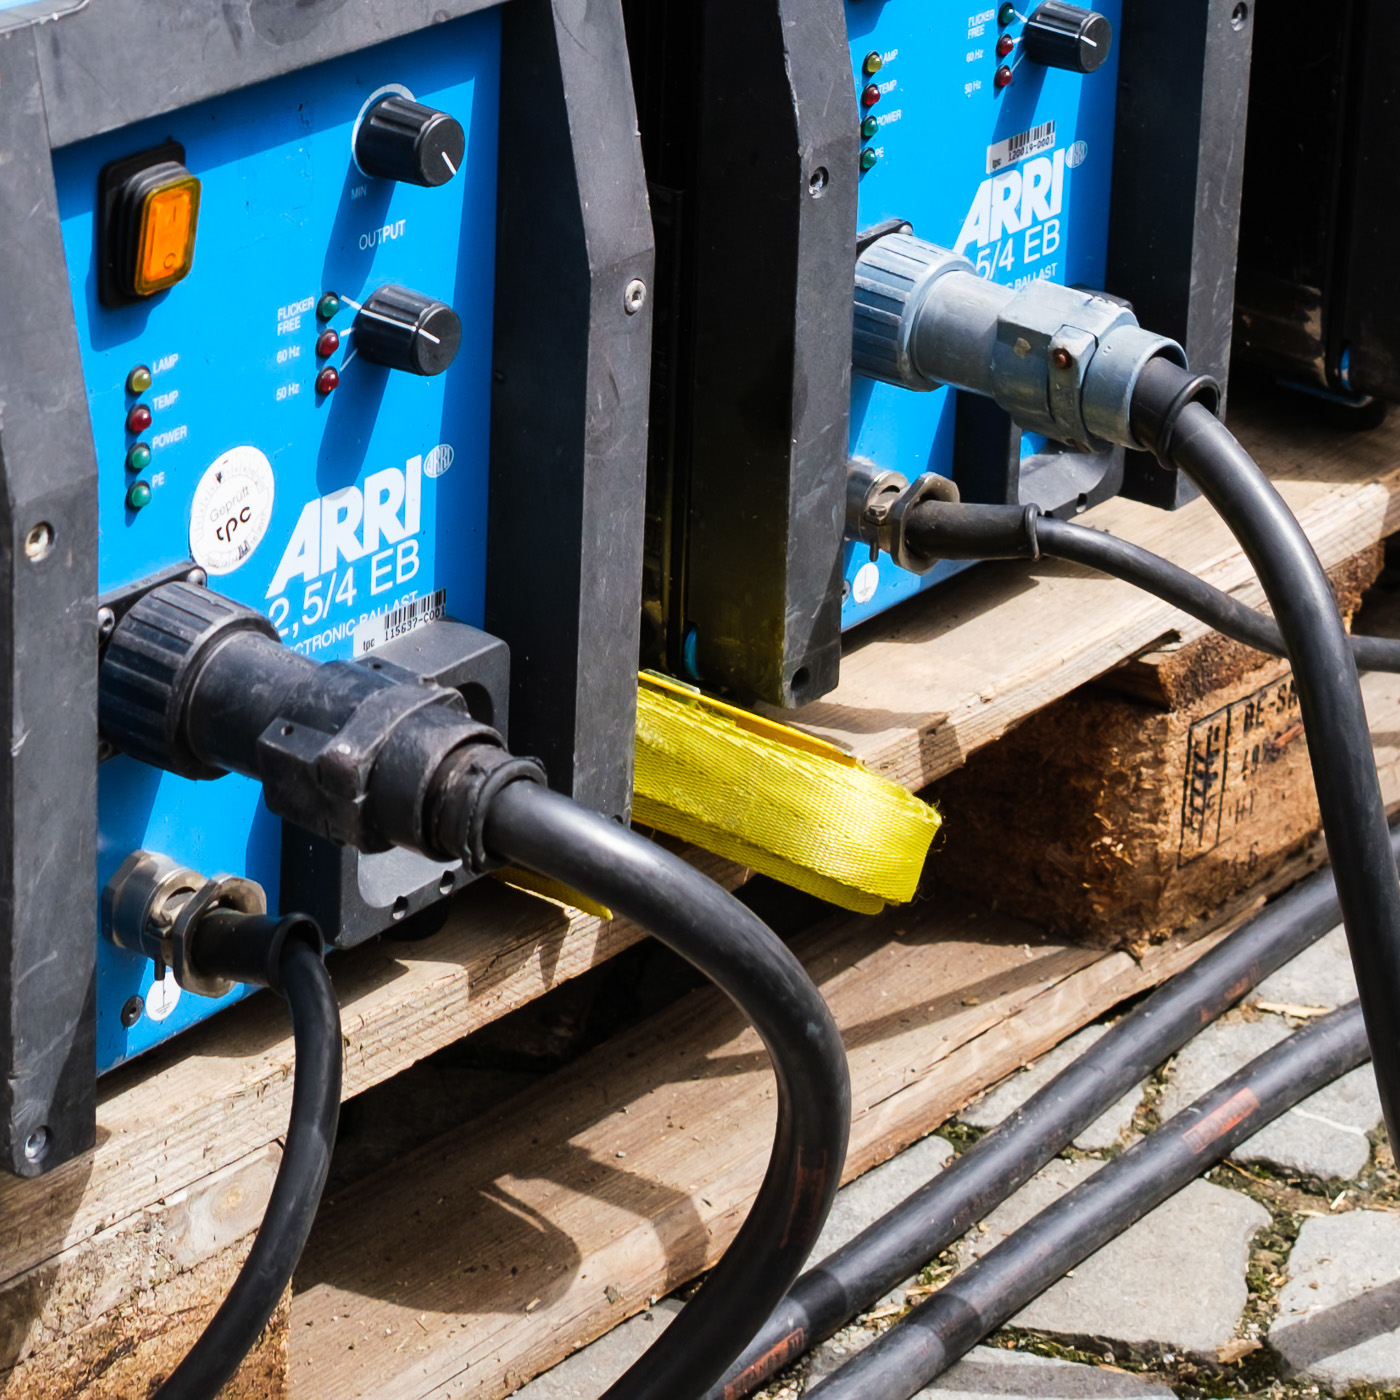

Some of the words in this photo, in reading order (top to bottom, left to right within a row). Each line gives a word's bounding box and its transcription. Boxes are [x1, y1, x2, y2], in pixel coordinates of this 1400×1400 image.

[967, 24, 986, 40] FREE
[975, 48, 985, 61] Hz
[877, 109, 902, 127] POWER
[351, 185, 367, 201] MIN
[952, 147, 1066, 256] ARRI
[359, 219, 407, 251] OUTPUT
[1024, 218, 1061, 264] EB
[277, 296, 316, 322] FLICKER
[277, 317, 301, 337] FREE
[152, 352, 179, 375] LAMP
[276, 349, 288, 364] 60
[288, 345, 300, 360] Hz
[152, 389, 179, 412] TEMP
[276, 386, 288, 401] 50
[288, 381, 300, 396] Hz
[152, 424, 188, 450] POWER
[152, 471, 166, 489] PE
[264, 453, 423, 600] ARRI
[370, 537, 421, 598] EB
